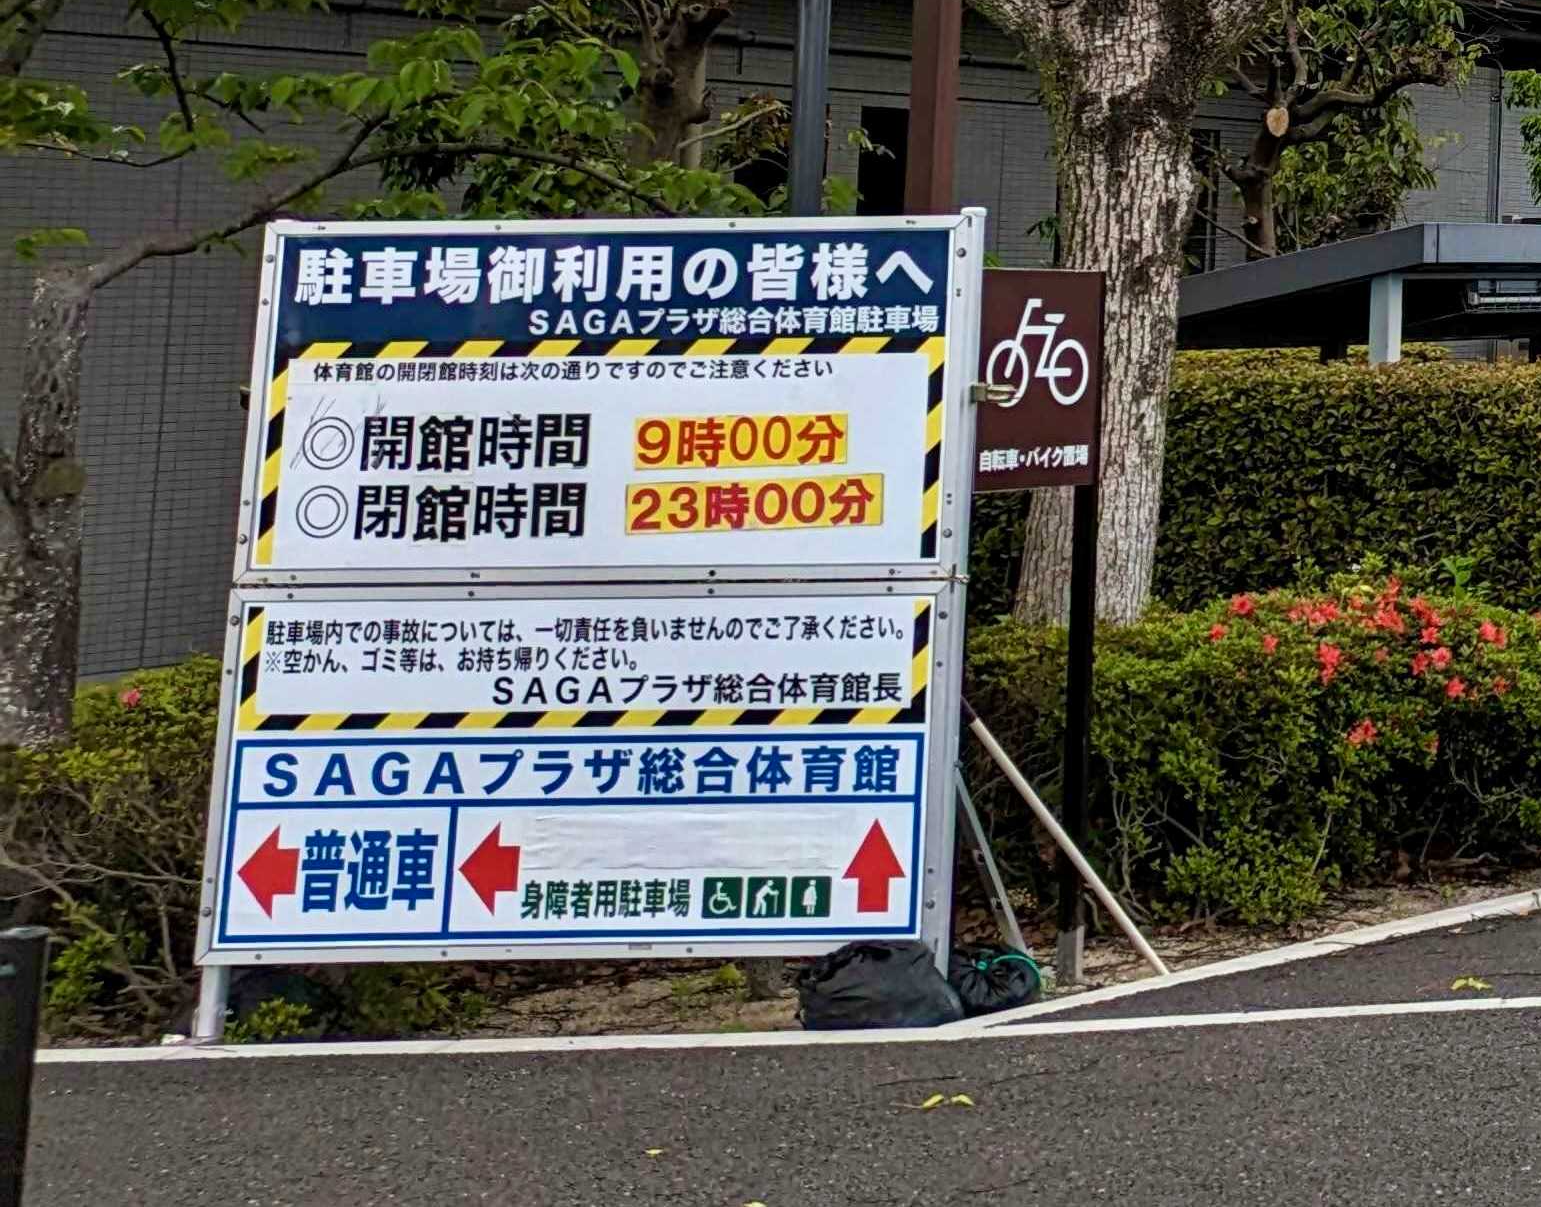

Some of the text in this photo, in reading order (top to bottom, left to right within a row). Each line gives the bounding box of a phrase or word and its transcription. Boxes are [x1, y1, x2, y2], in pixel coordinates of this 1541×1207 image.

[294, 243, 934, 306] 駐車場御利用の皆様へ
[528, 305, 940, 335] SAGAプラザ総合体育館駐車場
[313, 358, 834, 383] 体育館の開閉館時刻は次の通りですのでご注意ください
[636, 414, 844, 468] 9時00分
[630, 478, 875, 531] 23時00分
[266, 615, 904, 645] 駐車場内での事故については、一切責任を負いませんのでご了承ください。
[492, 672, 902, 705] SAGAプラザ総合体育館長
[263, 745, 900, 797] SAGAプラザ総合体育館
[301, 828, 439, 913] 普通車
[520, 877, 692, 920] 身障者用駐車場
